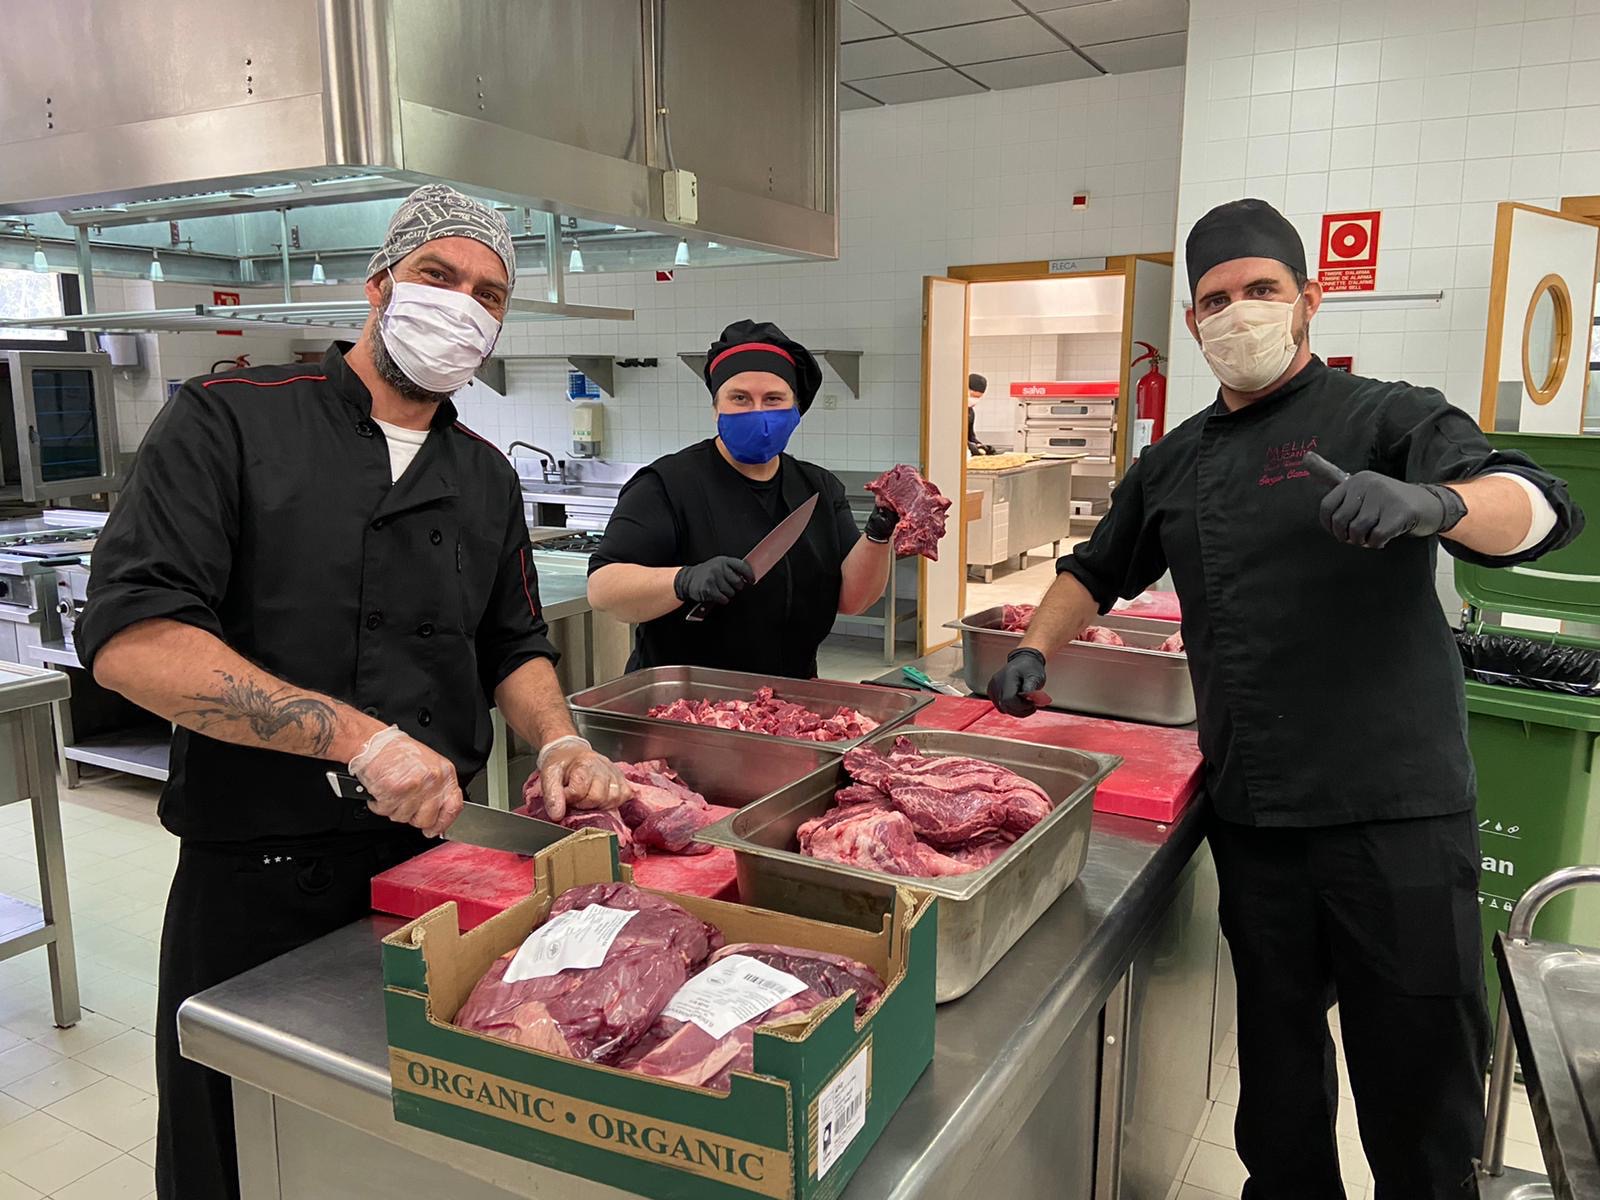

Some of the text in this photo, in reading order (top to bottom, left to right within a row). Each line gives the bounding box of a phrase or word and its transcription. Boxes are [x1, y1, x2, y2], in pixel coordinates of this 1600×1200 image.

[1480, 855, 1514, 876] an
[407, 1061, 555, 1123] ORGANIC
[588, 1113, 764, 1181] ORGANIC
